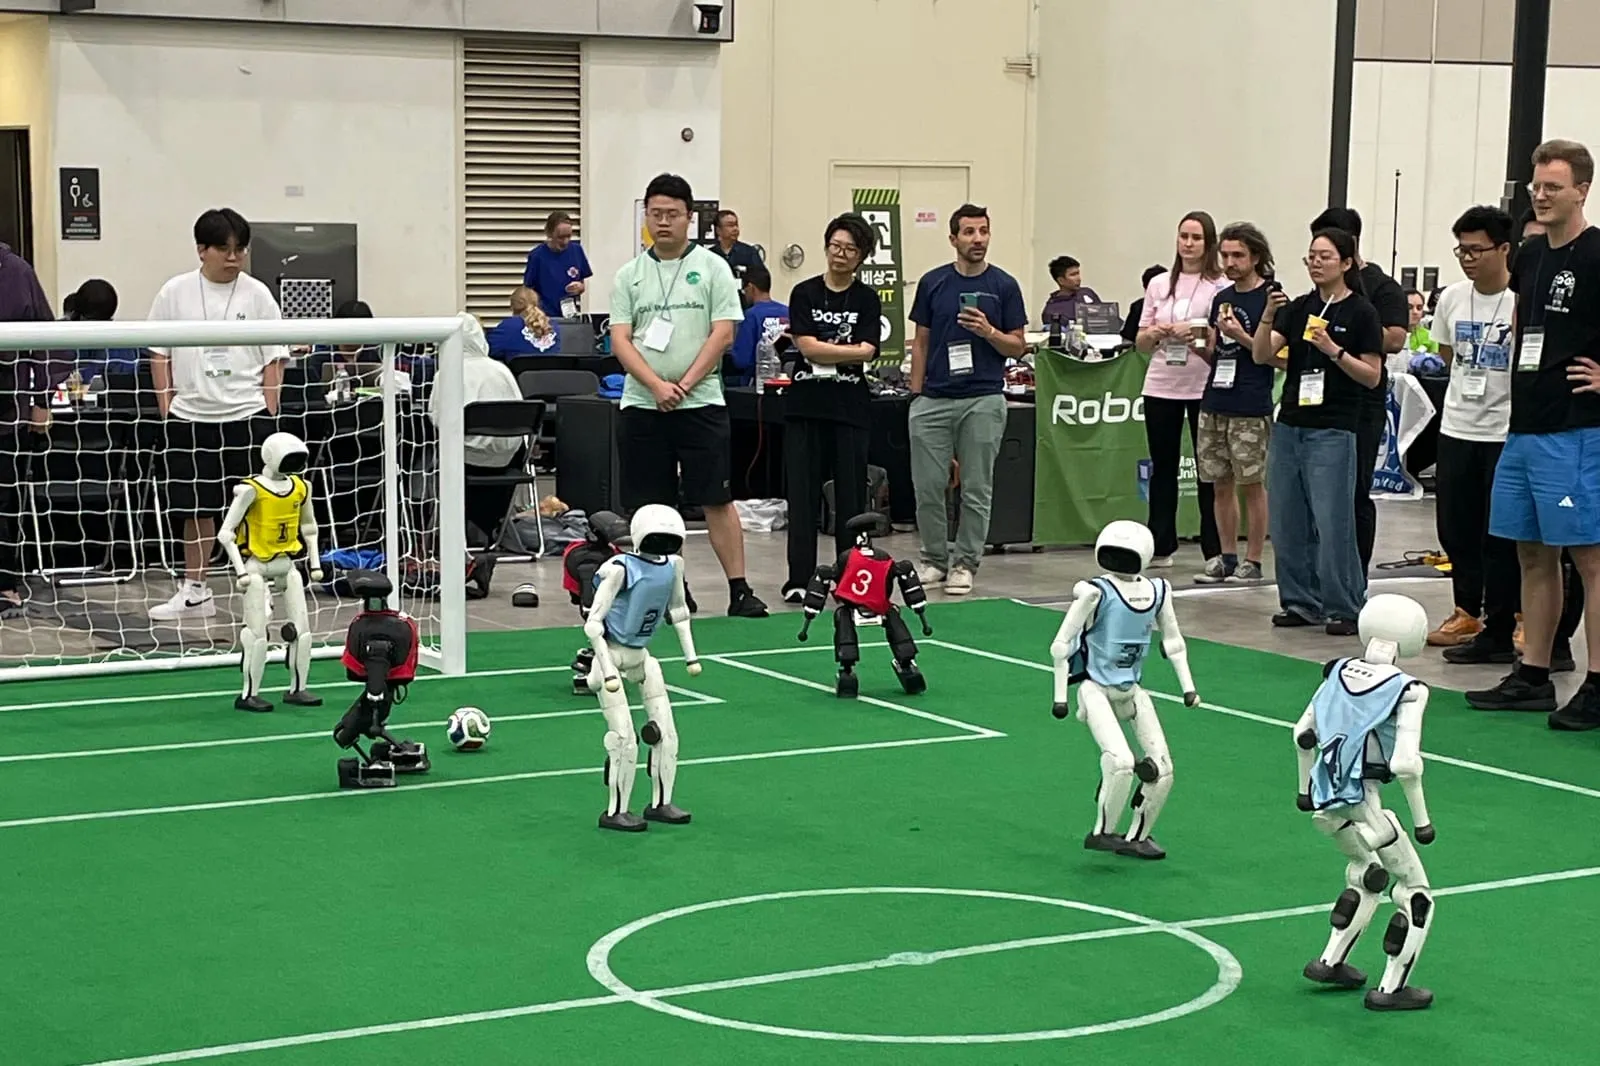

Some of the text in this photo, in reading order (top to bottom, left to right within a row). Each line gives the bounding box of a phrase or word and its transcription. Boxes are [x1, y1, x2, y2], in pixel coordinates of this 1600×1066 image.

[861, 270, 898, 286] 비상구
[277, 522, 289, 543] 1
[851, 569, 873, 596] 3
[635, 609, 659, 637] 2
[1116, 643, 1144, 669] 3
